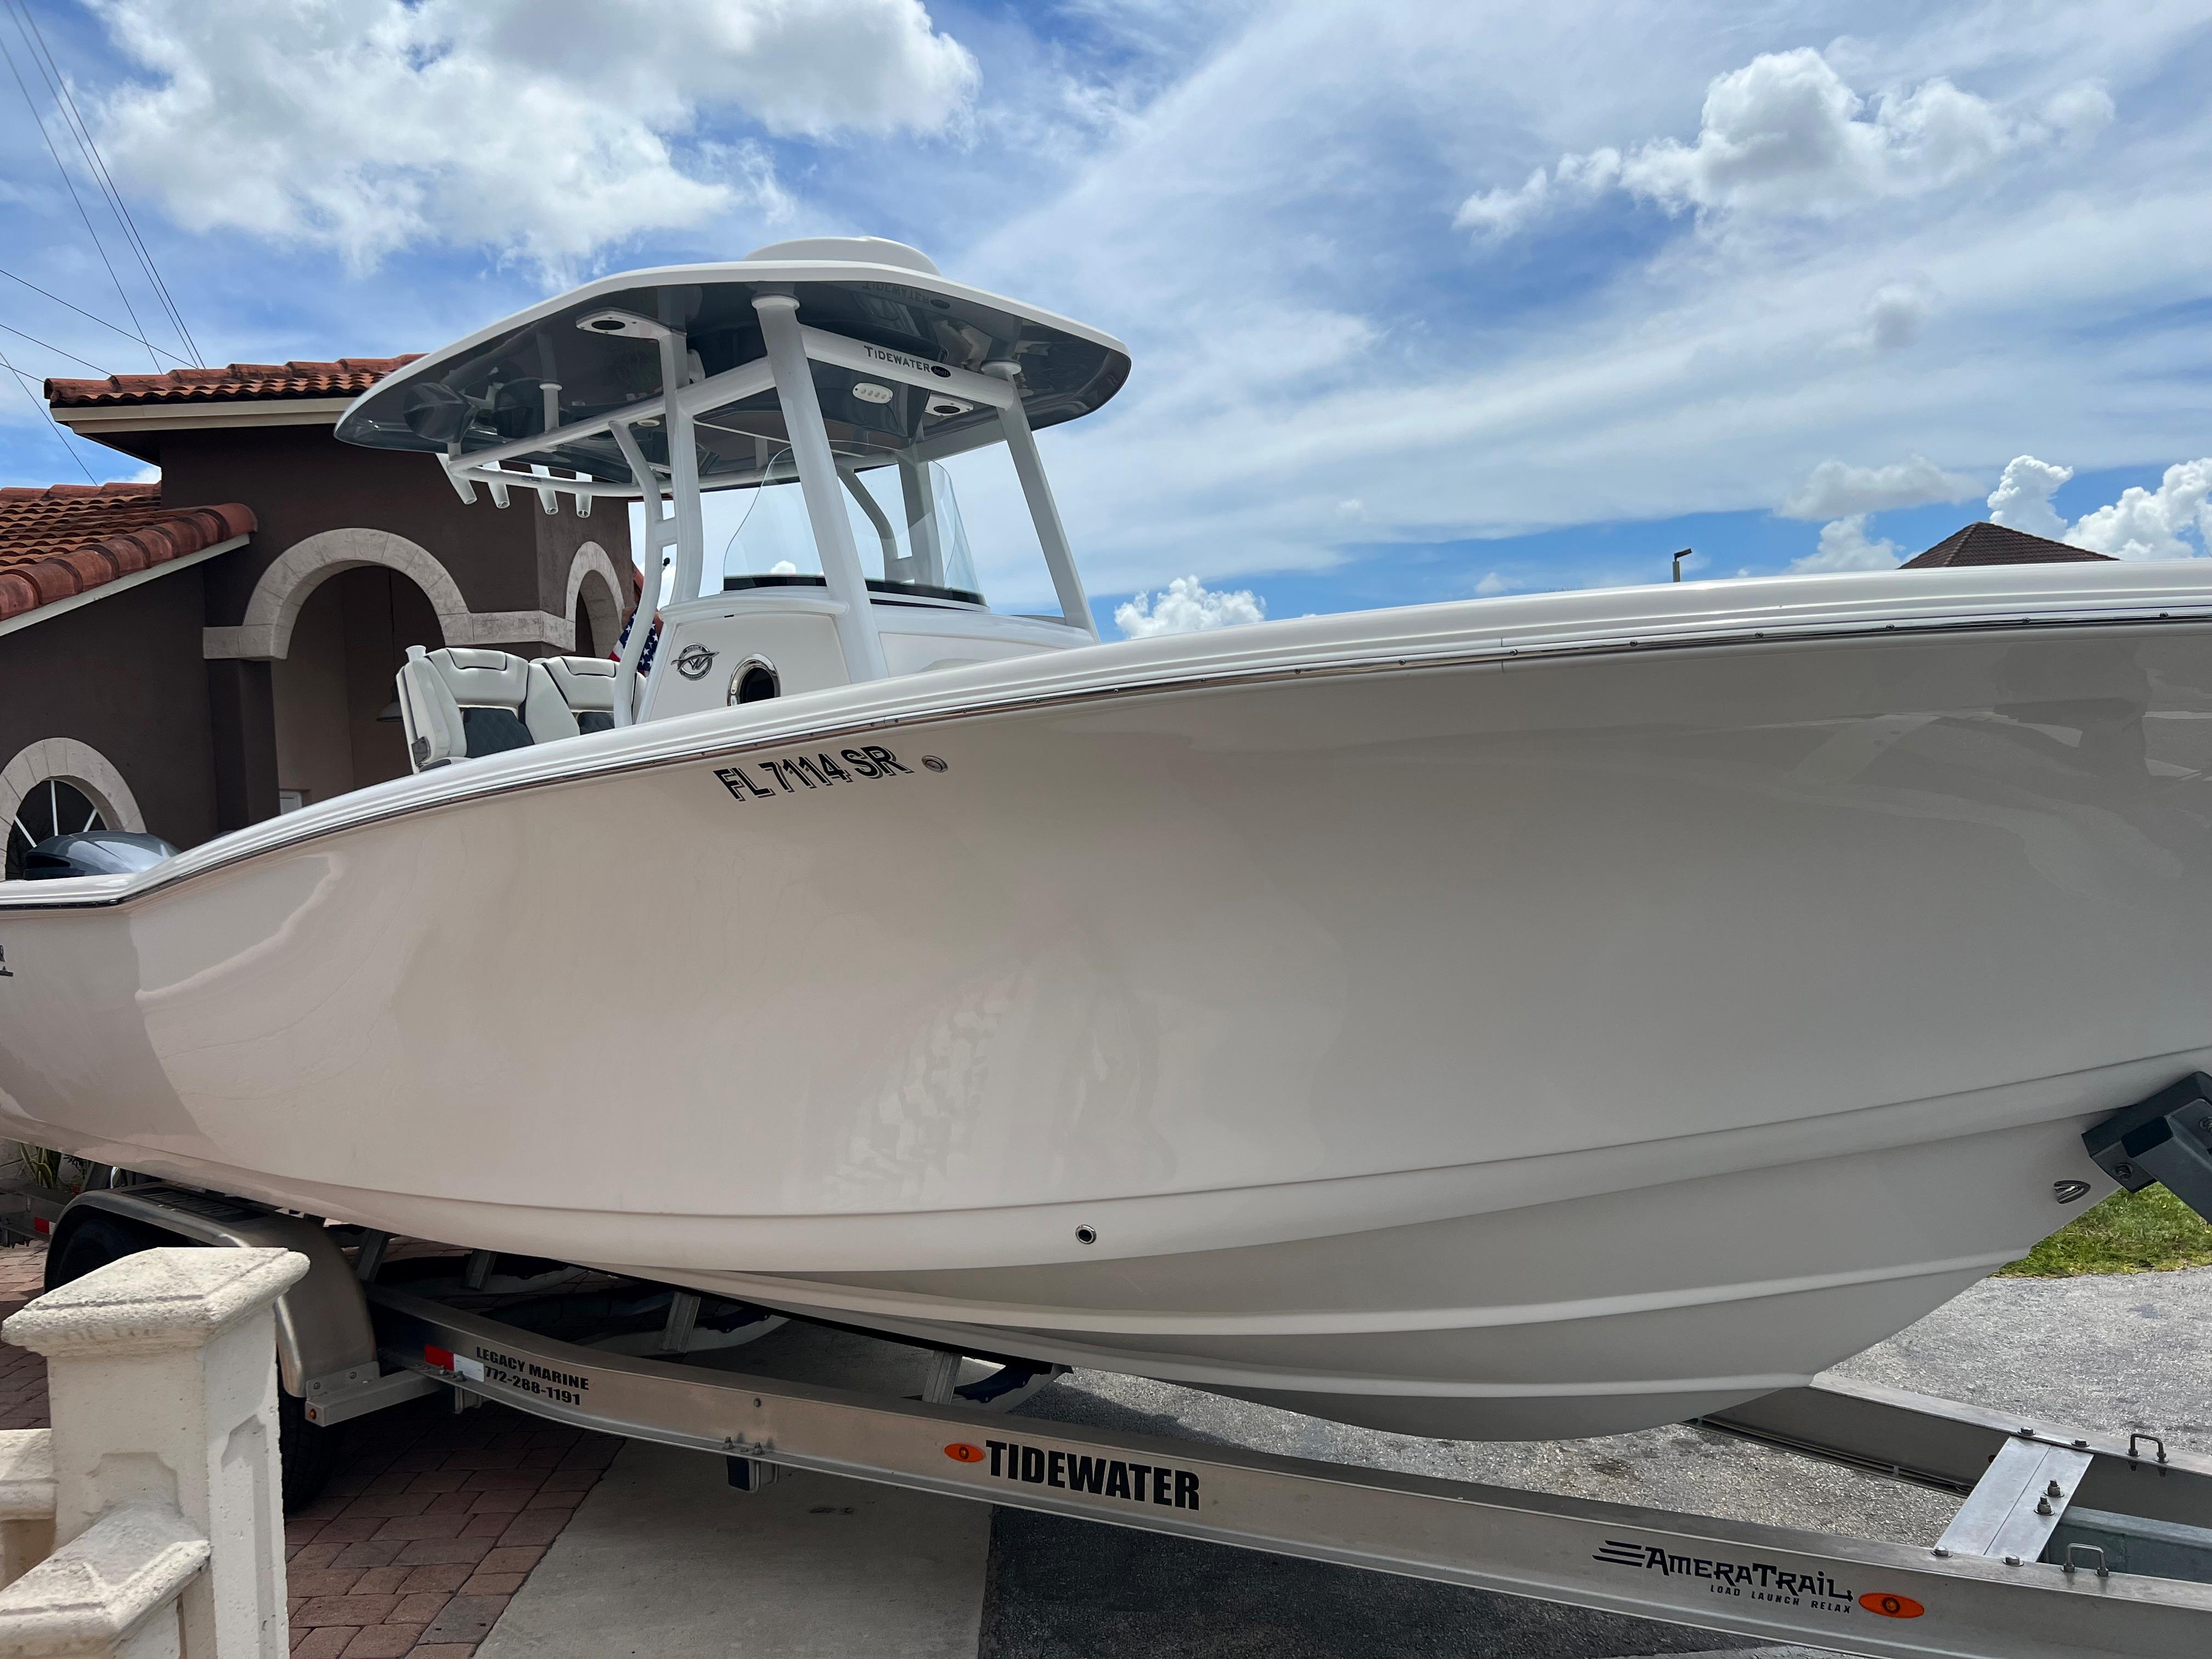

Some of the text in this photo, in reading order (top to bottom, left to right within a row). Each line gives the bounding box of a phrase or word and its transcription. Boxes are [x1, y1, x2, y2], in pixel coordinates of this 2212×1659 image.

[863, 345, 950, 377] TIDEWATER boats
[713, 745, 915, 802] FL 7114 SR
[476, 1346, 589, 1391] LEGACY MARINE
[484, 1365, 580, 1406] 772-288-1191
[985, 1439, 1200, 1511] TIDEWATER
[1710, 1584, 1852, 1615] LOAD LAUNCH RELAX
